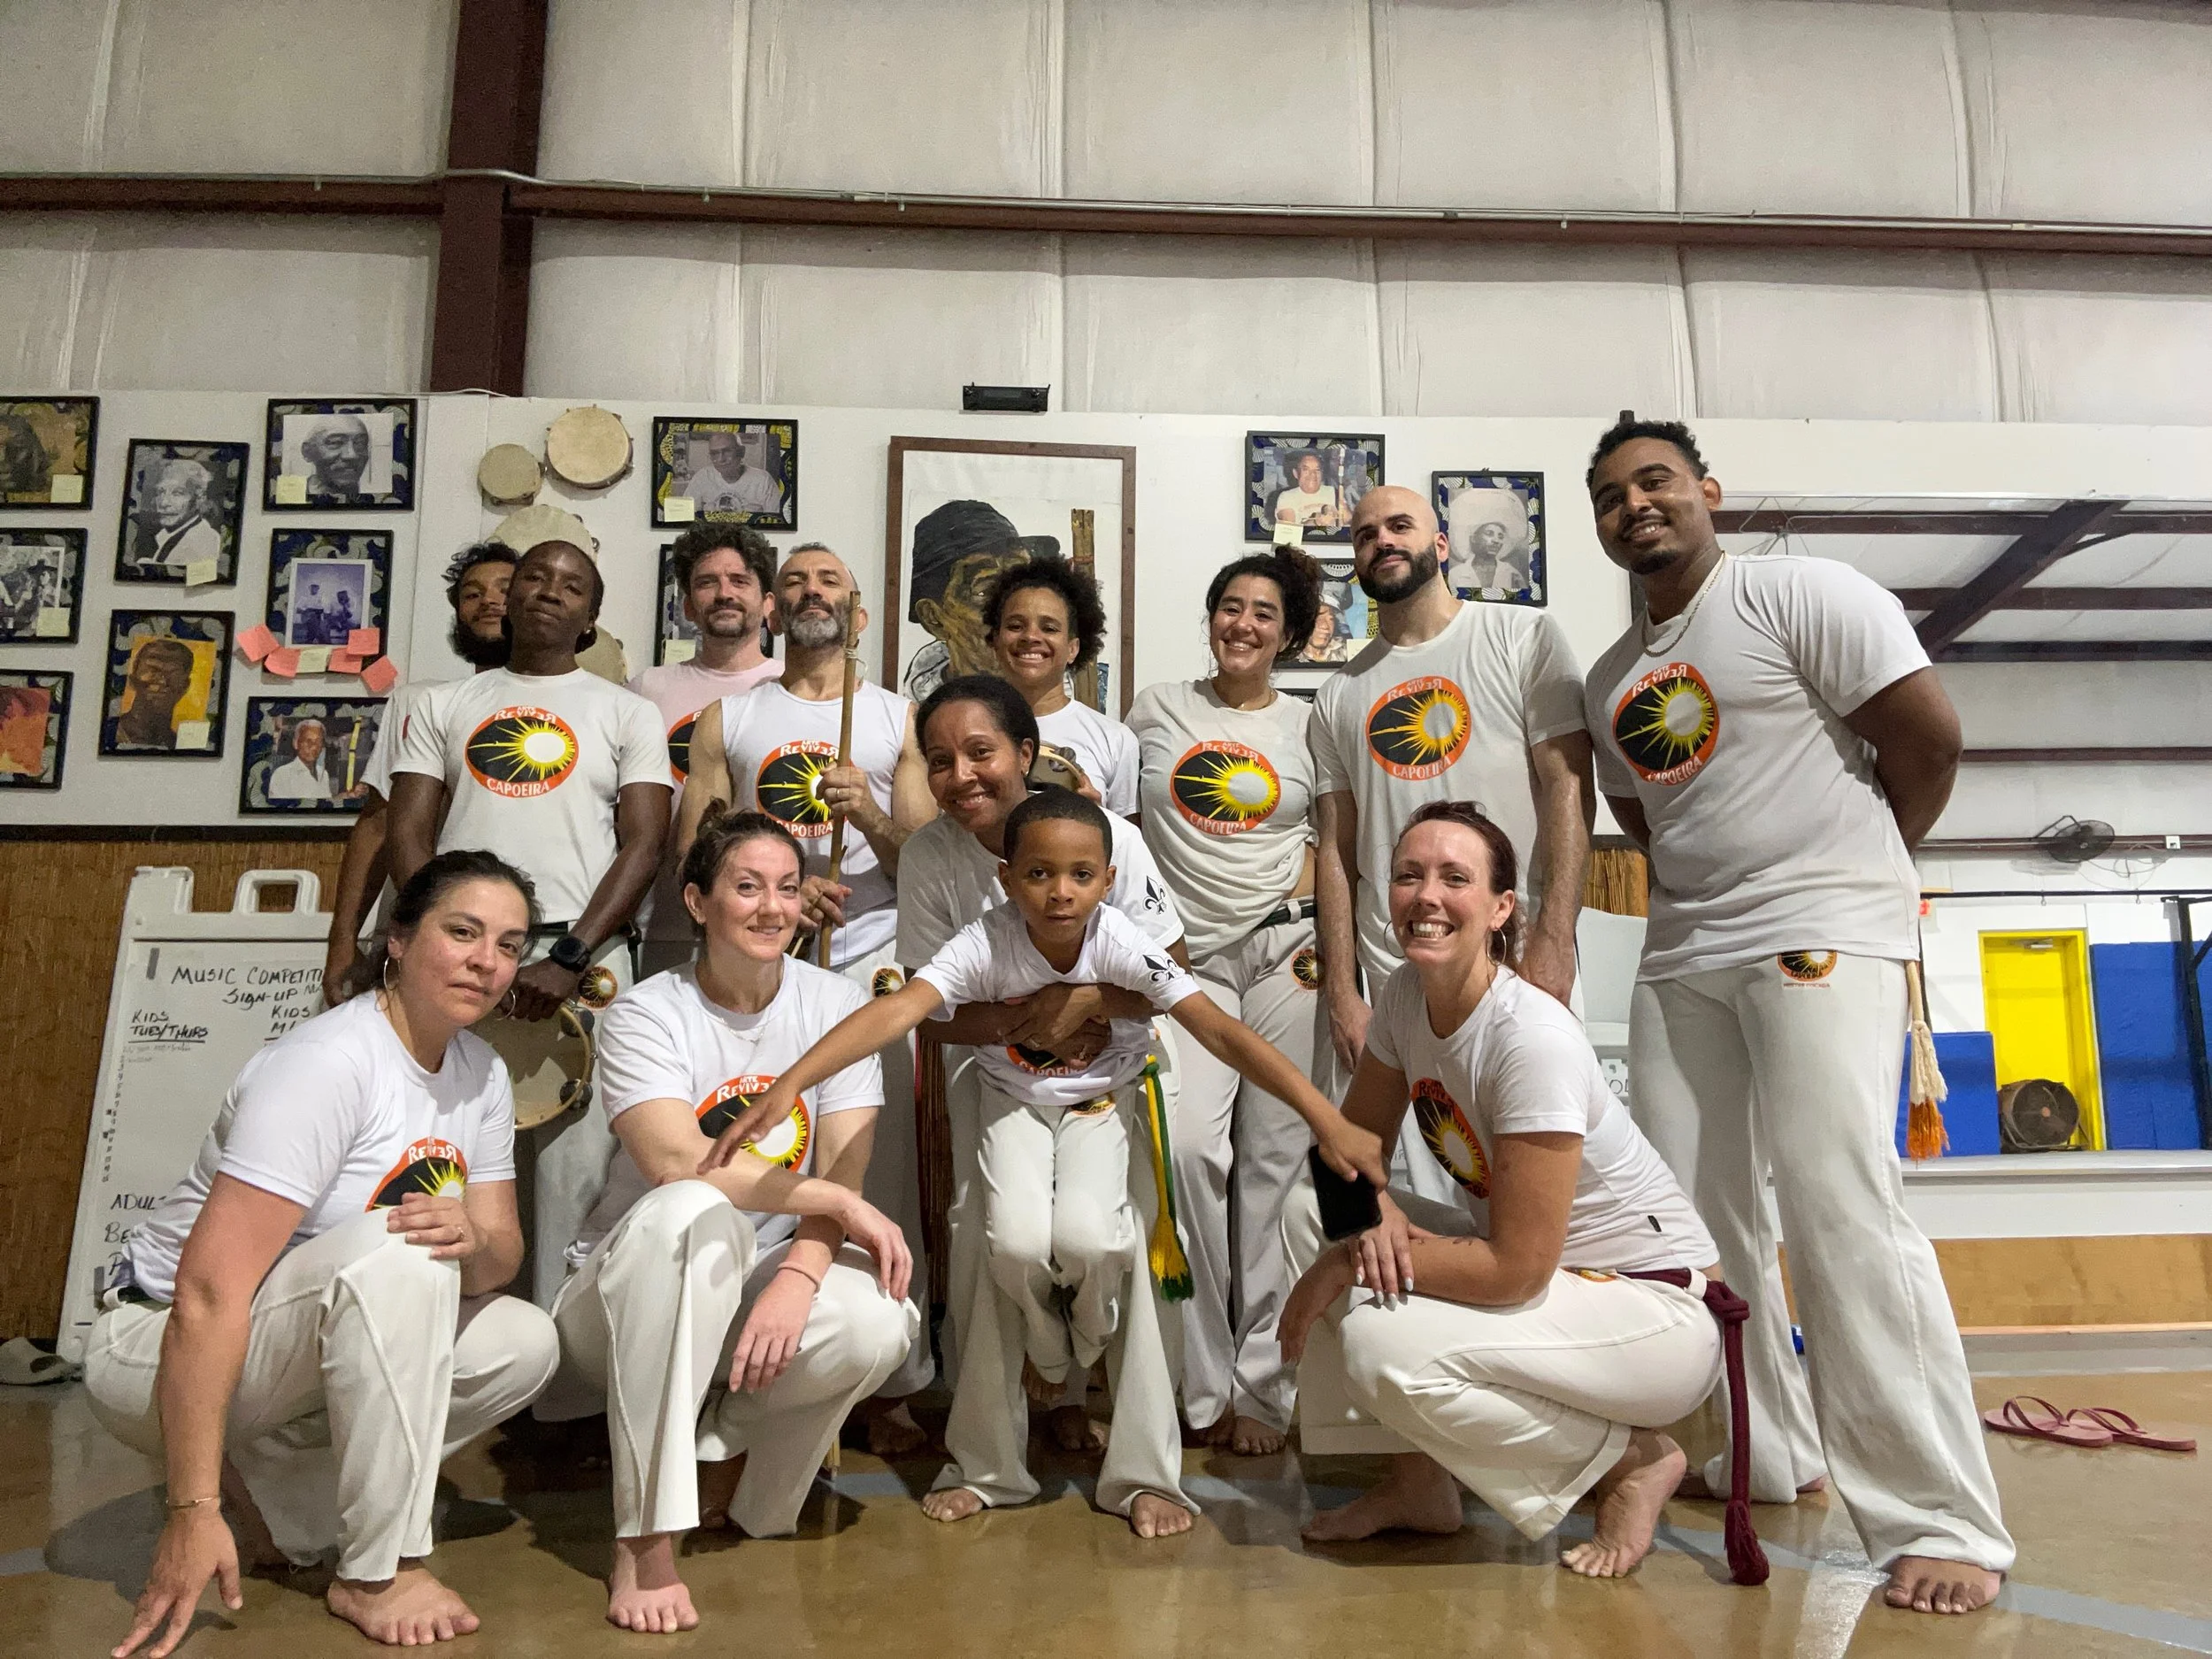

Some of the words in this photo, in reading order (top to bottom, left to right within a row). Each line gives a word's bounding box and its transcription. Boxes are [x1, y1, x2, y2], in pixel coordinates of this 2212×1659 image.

[1393, 756, 1451, 779] CAPOEIRA
[487, 778, 549, 796] CAPOEIRA
[1189, 813, 1246, 834] CAPOEIRA
[171, 964, 236, 985] MUSIC
[132, 1009, 169, 1023] KIDS
[271, 1004, 311, 1018] KIDS
[111, 1194, 166, 1210] ADUL
